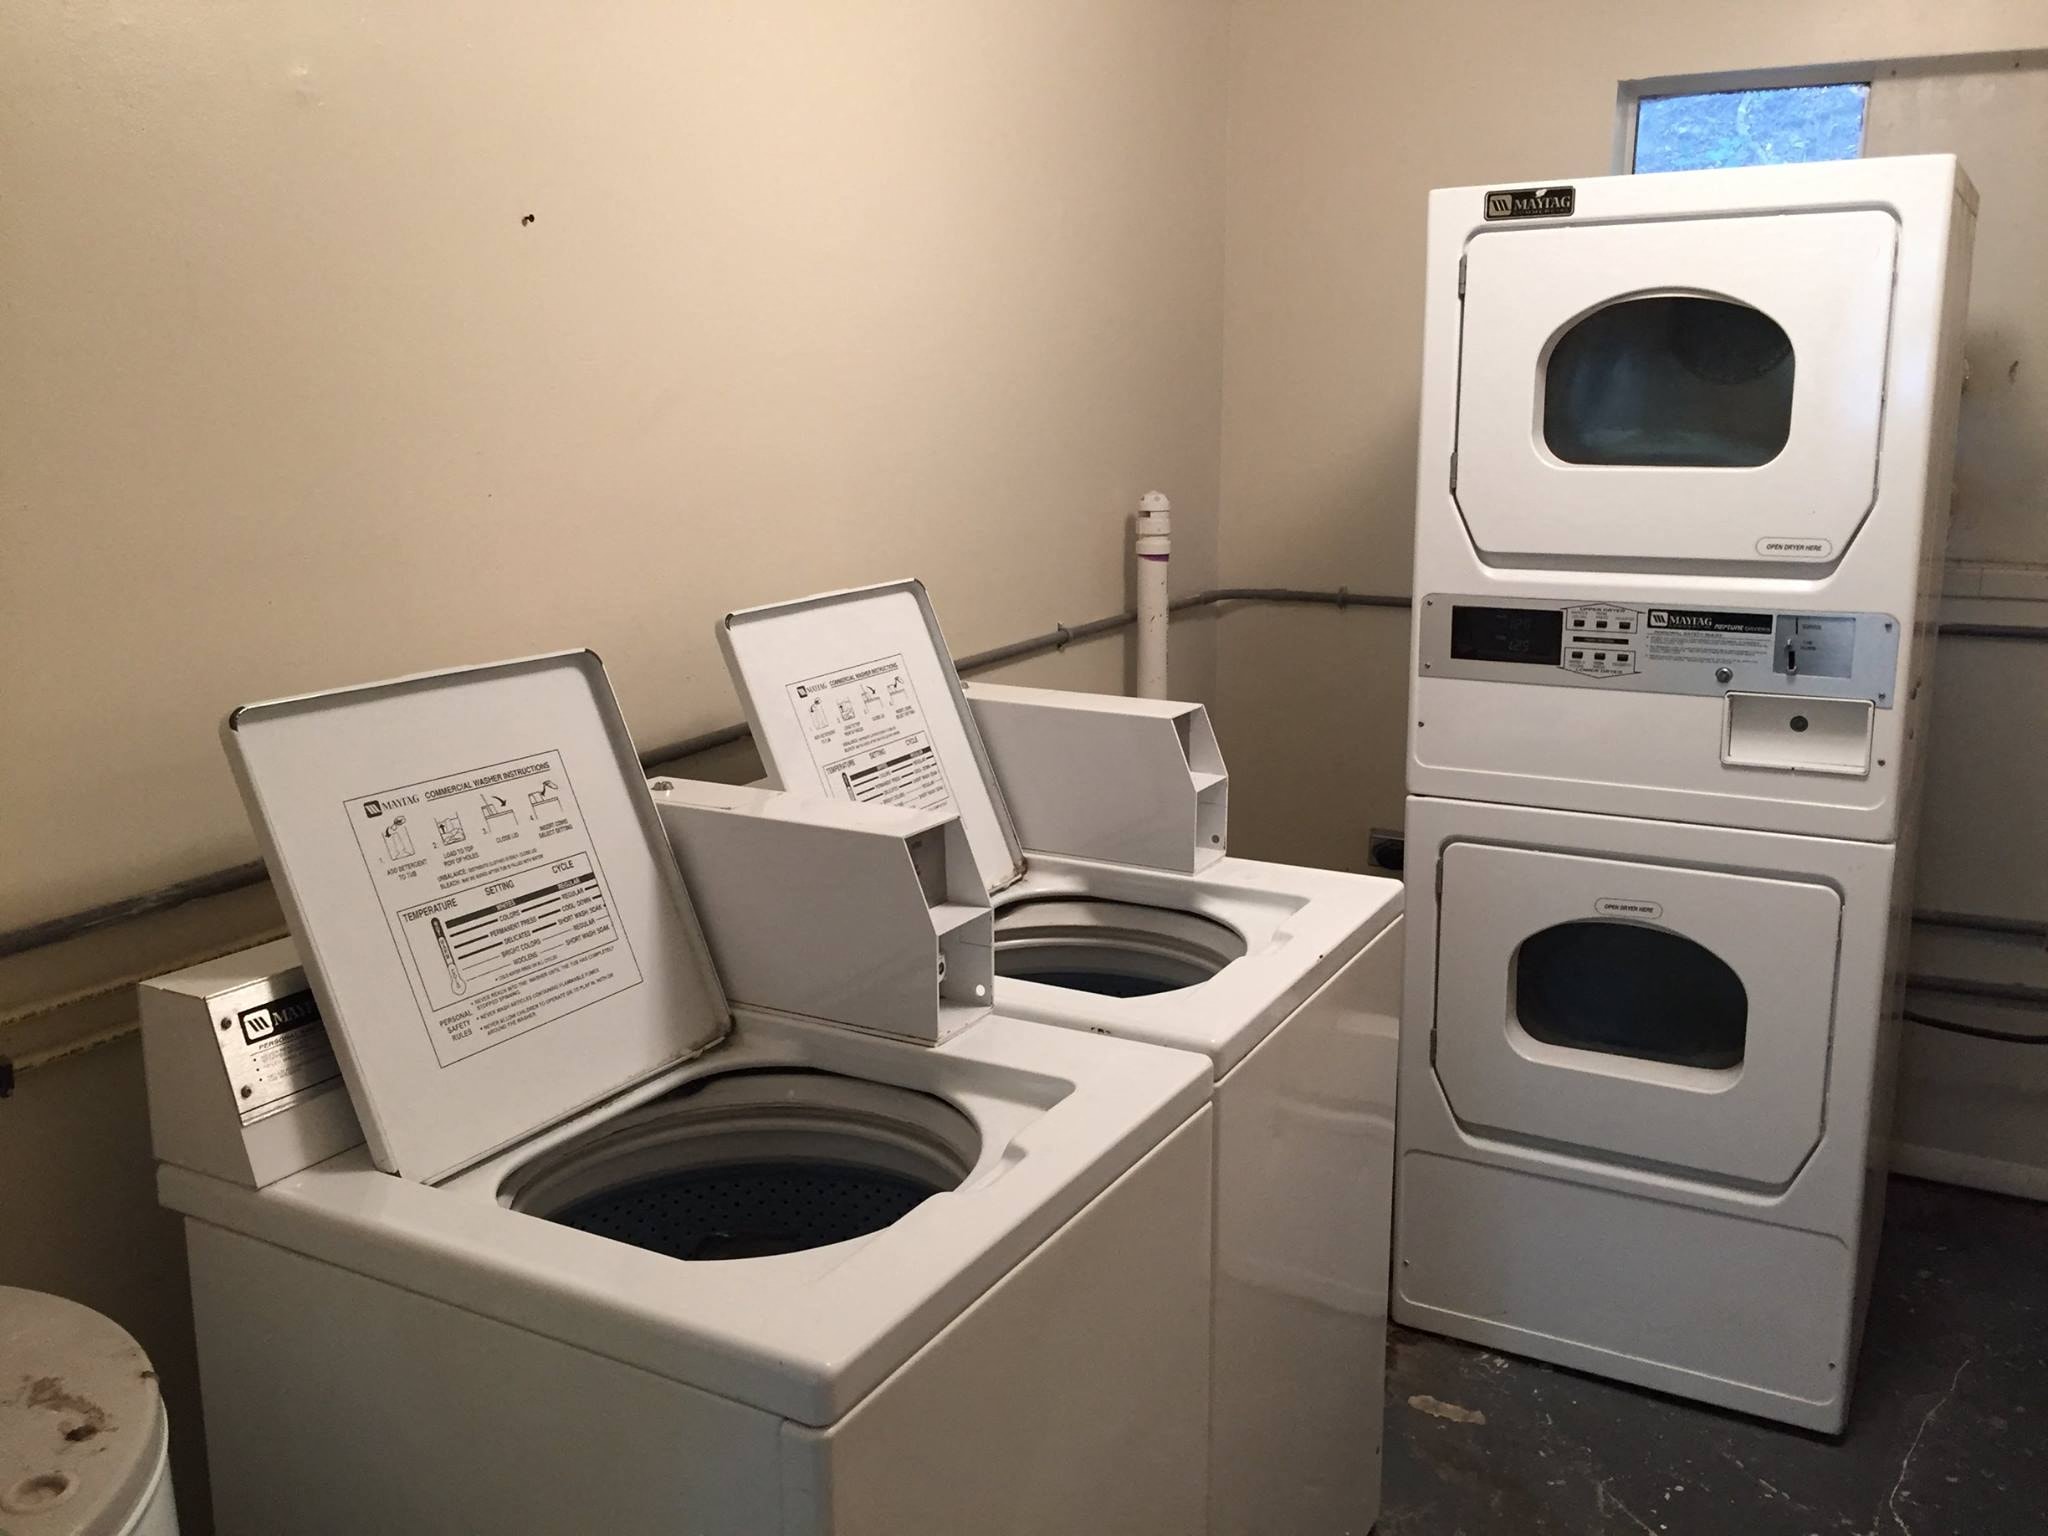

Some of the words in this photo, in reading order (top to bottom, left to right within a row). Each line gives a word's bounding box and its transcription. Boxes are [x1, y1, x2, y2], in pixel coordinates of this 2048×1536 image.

[1515, 196, 1571, 210] MAYTAG
[1669, 615, 1712, 627] MAYTAG
[424, 782, 472, 799] COMMERCIAL
[473, 774, 502, 786] WASHER
[502, 762, 550, 779] INSTRUCTIONS
[381, 795, 420, 811] MAYTAG
[552, 861, 574, 873] CYCLE
[484, 880, 514, 895] SETTING
[561, 888, 584, 900] REGULAR
[403, 899, 457, 922] TEMPERATURE
[561, 902, 578, 911] COOL
[579, 897, 591, 905] DOWN
[499, 910, 520, 921] COLORS
[558, 915, 574, 925] SHORT
[574, 909, 589, 919] WASH
[589, 904, 603, 913] SOAK
[489, 923, 519, 937] PERMANENT
[520, 917, 537, 926] PRESS
[573, 919, 595, 931] REGULAR
[504, 931, 530, 945] DELICATES
[565, 935, 581, 945] SHORT
[596, 924, 609, 933] SOAK
[501, 947, 520, 958] BRIGHT
[520, 939, 541, 950] COLORS
[439, 1010, 472, 1027] PERSONAL
[447, 1020, 470, 1034] SAFETY
[452, 1029, 472, 1041] RULES
